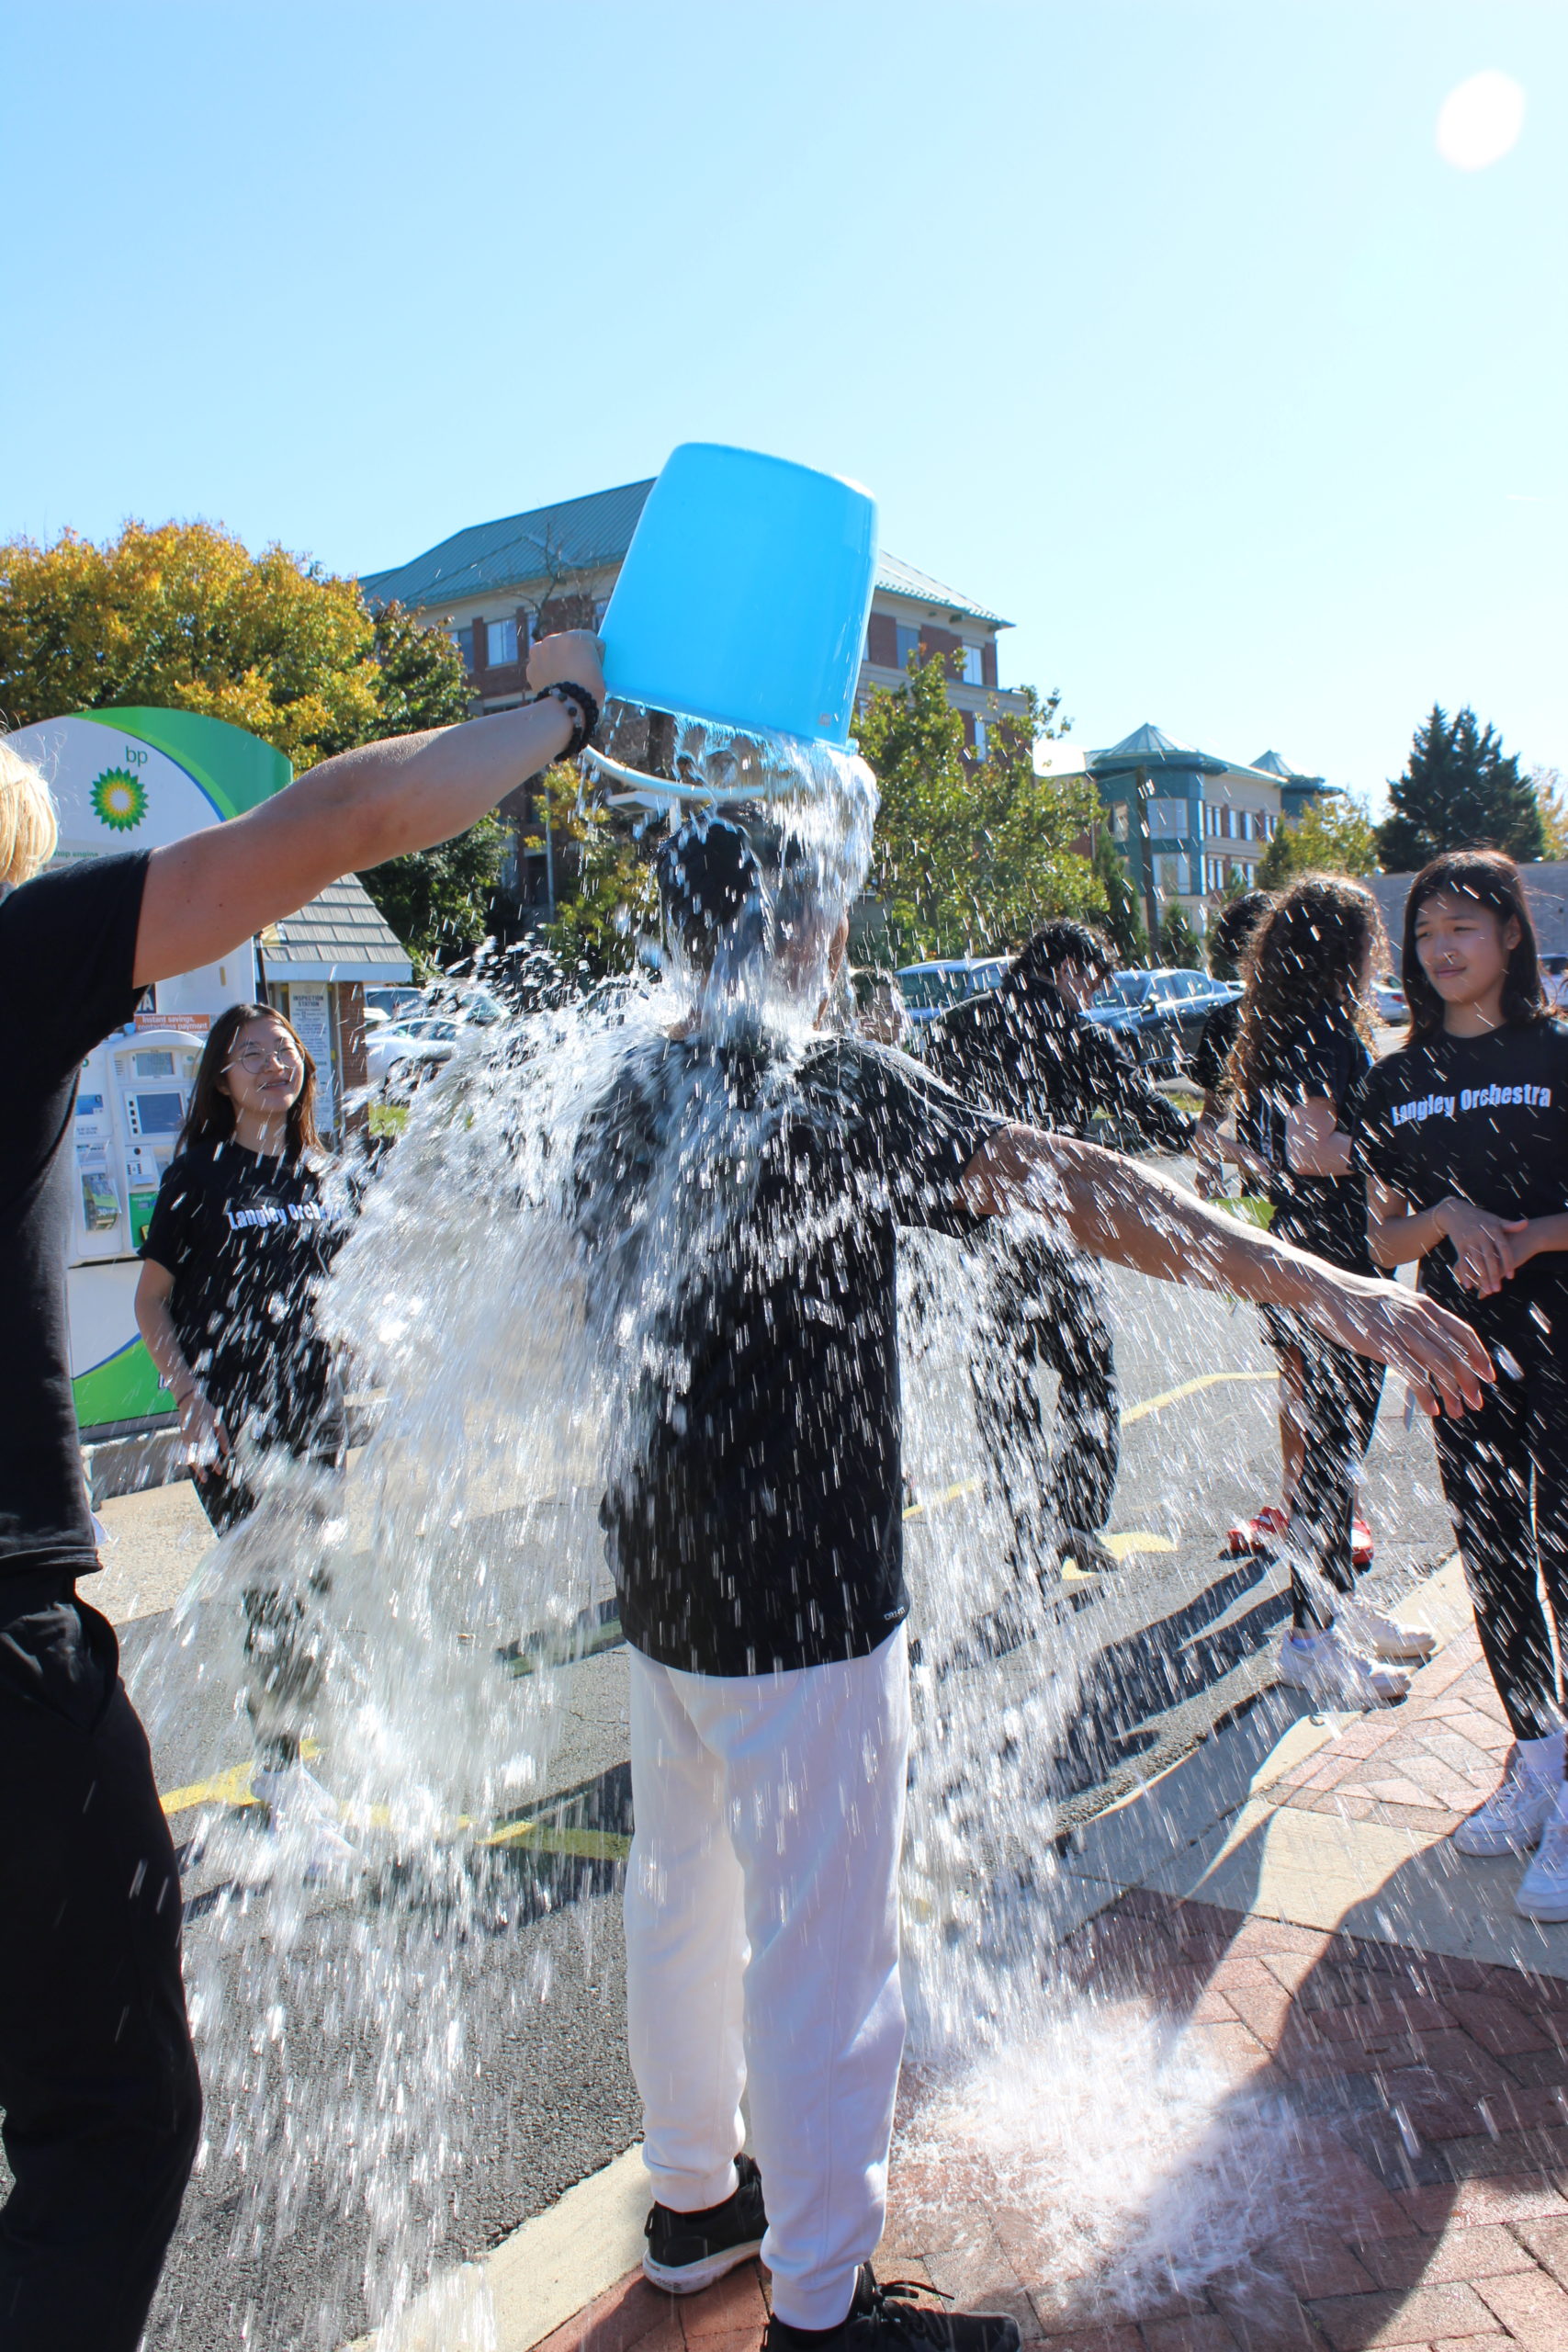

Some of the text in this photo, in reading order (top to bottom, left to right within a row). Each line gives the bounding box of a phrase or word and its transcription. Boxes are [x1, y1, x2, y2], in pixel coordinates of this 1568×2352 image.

[126, 745, 148, 767] bp
[177, 1023, 208, 1031] payment
[1391, 1084, 1551, 1126] Langley Orchestra
[227, 1204, 288, 1230] Langley
